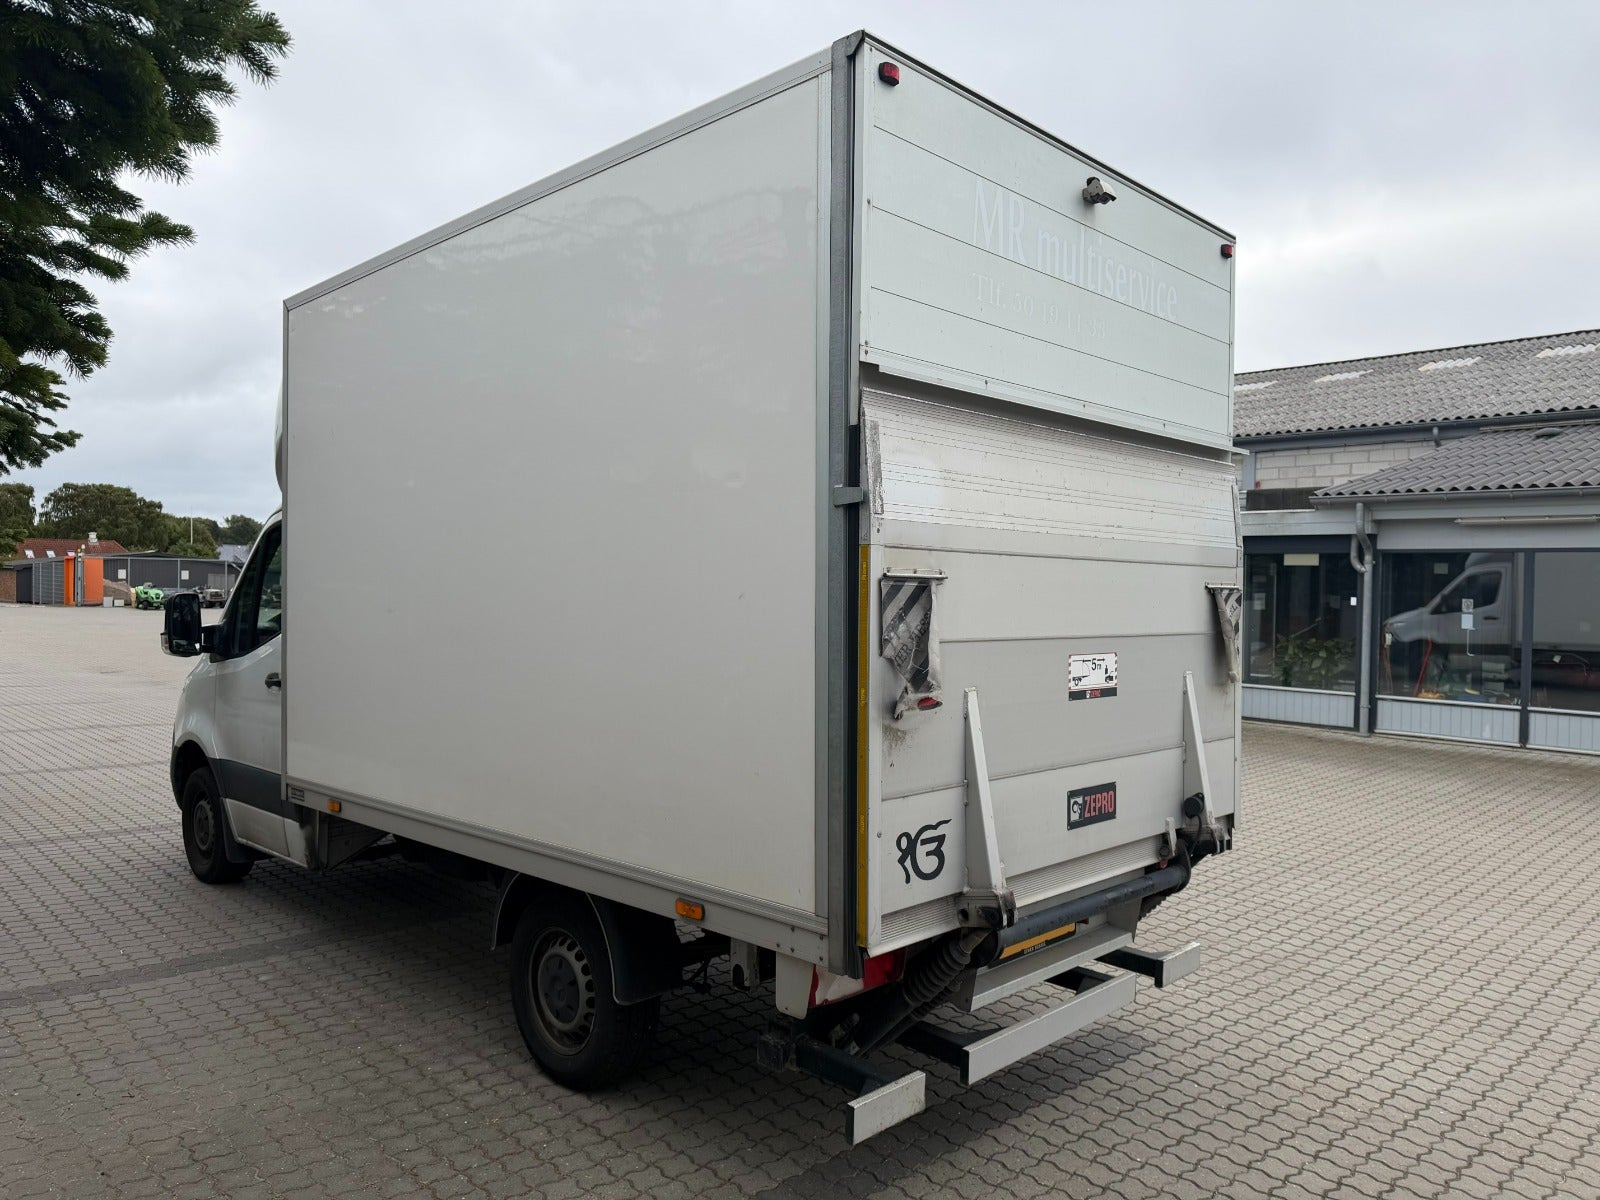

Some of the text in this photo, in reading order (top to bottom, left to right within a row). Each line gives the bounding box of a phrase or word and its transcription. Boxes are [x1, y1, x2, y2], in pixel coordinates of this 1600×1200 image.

[972, 176, 1178, 321] MR multiservice
[1084, 790, 1115, 818] ZEPRO
